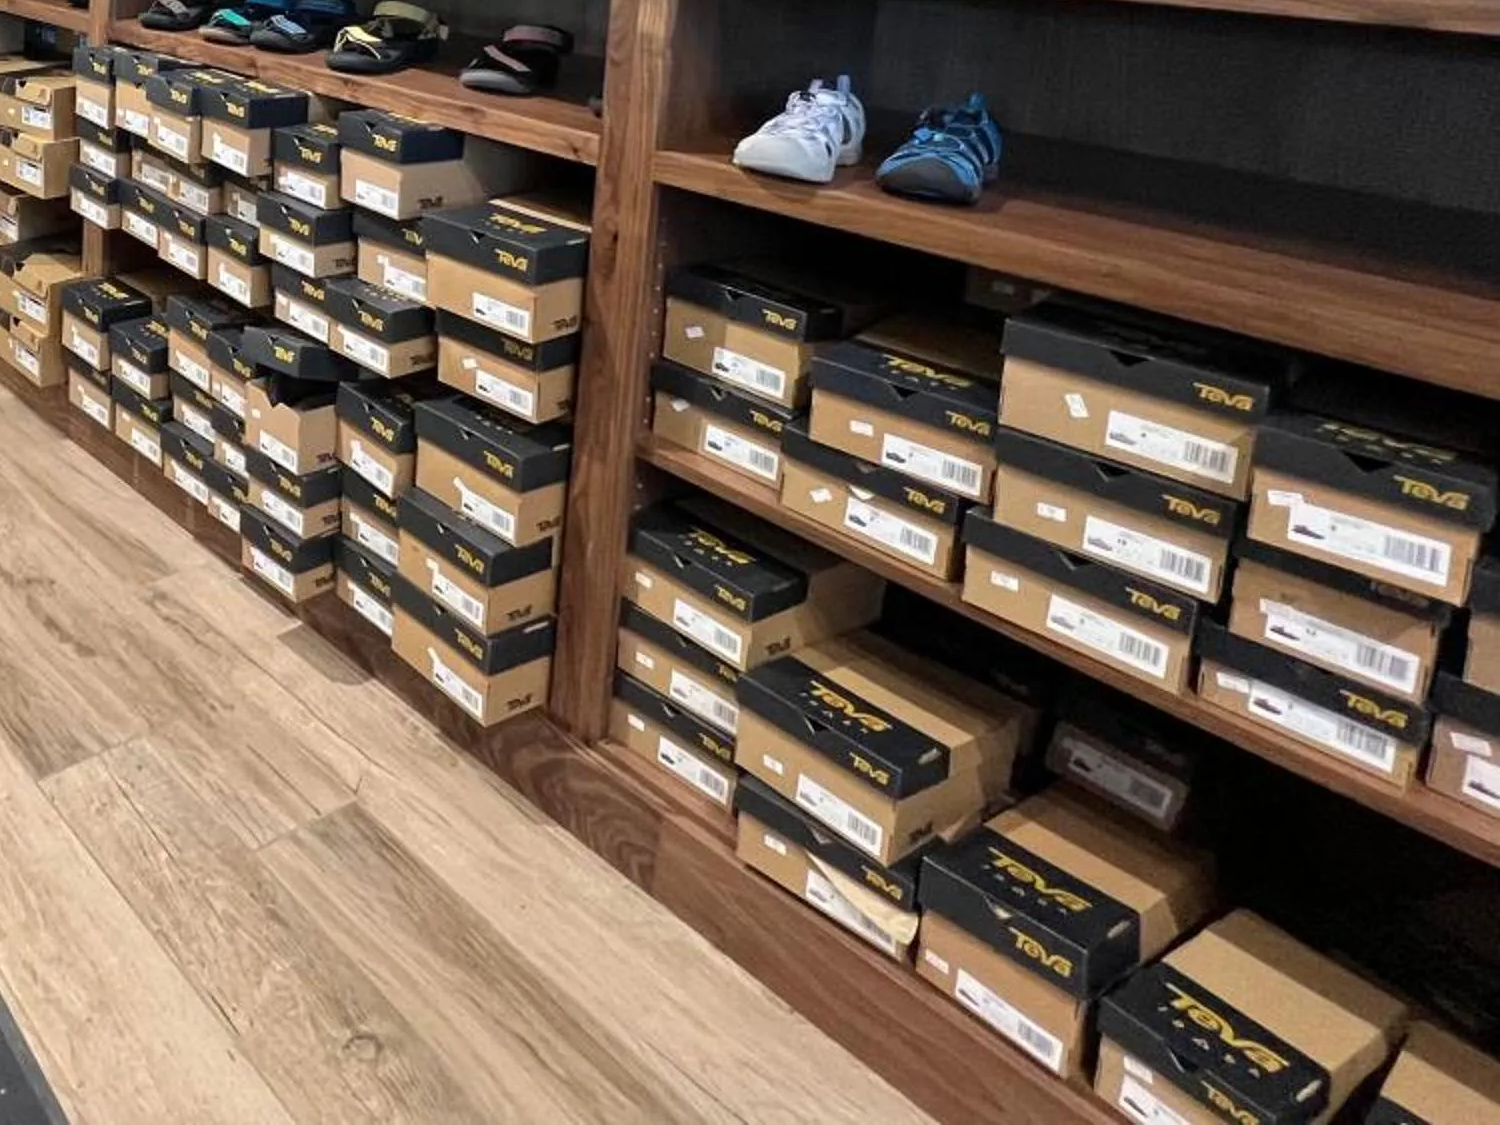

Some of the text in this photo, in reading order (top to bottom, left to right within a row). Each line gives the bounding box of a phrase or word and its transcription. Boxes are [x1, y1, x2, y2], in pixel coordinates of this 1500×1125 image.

[1193, 382, 1255, 411] Teva
[1161, 493, 1221, 526] Teva
[1394, 475, 1469, 511] Teva
[1124, 586, 1181, 621] Teva
[1339, 689, 1408, 729] Teva
[988, 846, 1093, 913] Teva
[1008, 926, 1073, 978] Teva
[1163, 982, 1291, 1073] Teva
